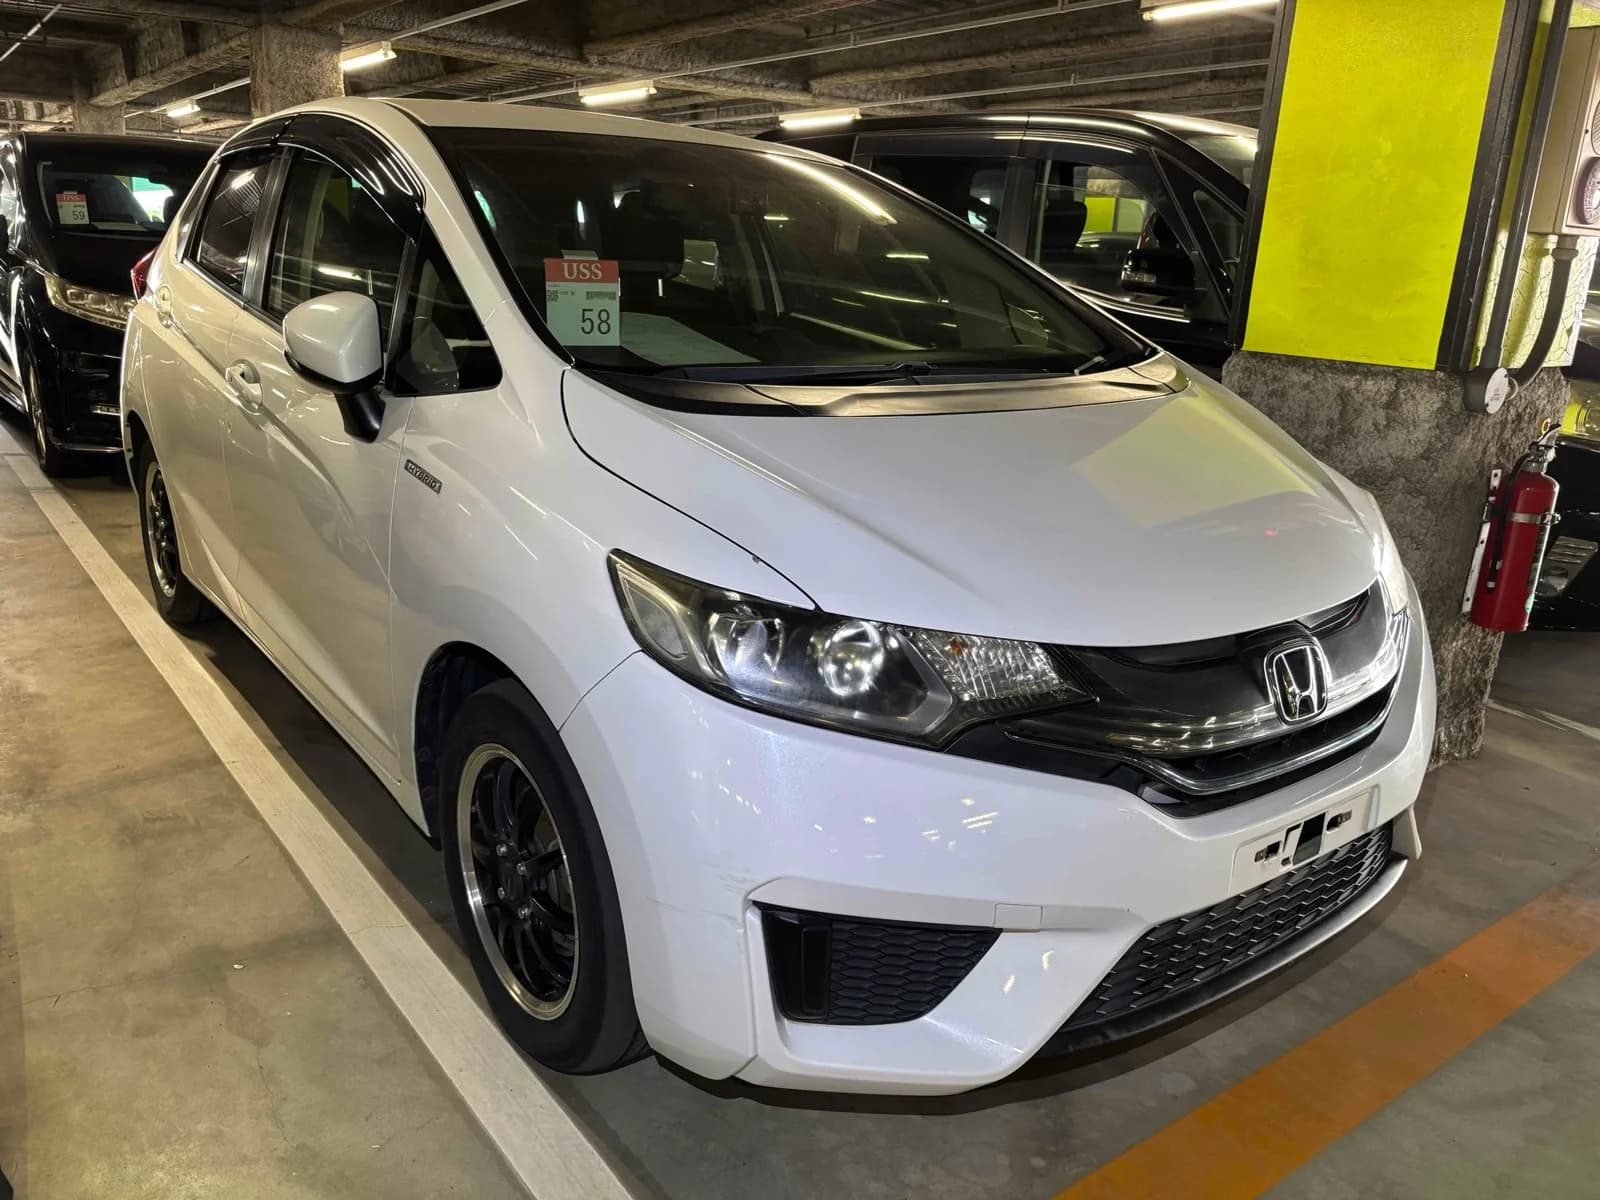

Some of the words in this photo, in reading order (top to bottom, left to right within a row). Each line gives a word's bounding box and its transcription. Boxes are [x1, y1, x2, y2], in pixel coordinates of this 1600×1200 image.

[72, 210, 85, 221] 59
[562, 262, 603, 280] USS
[580, 308, 611, 335] 58
[408, 462, 436, 488] HYBRID
